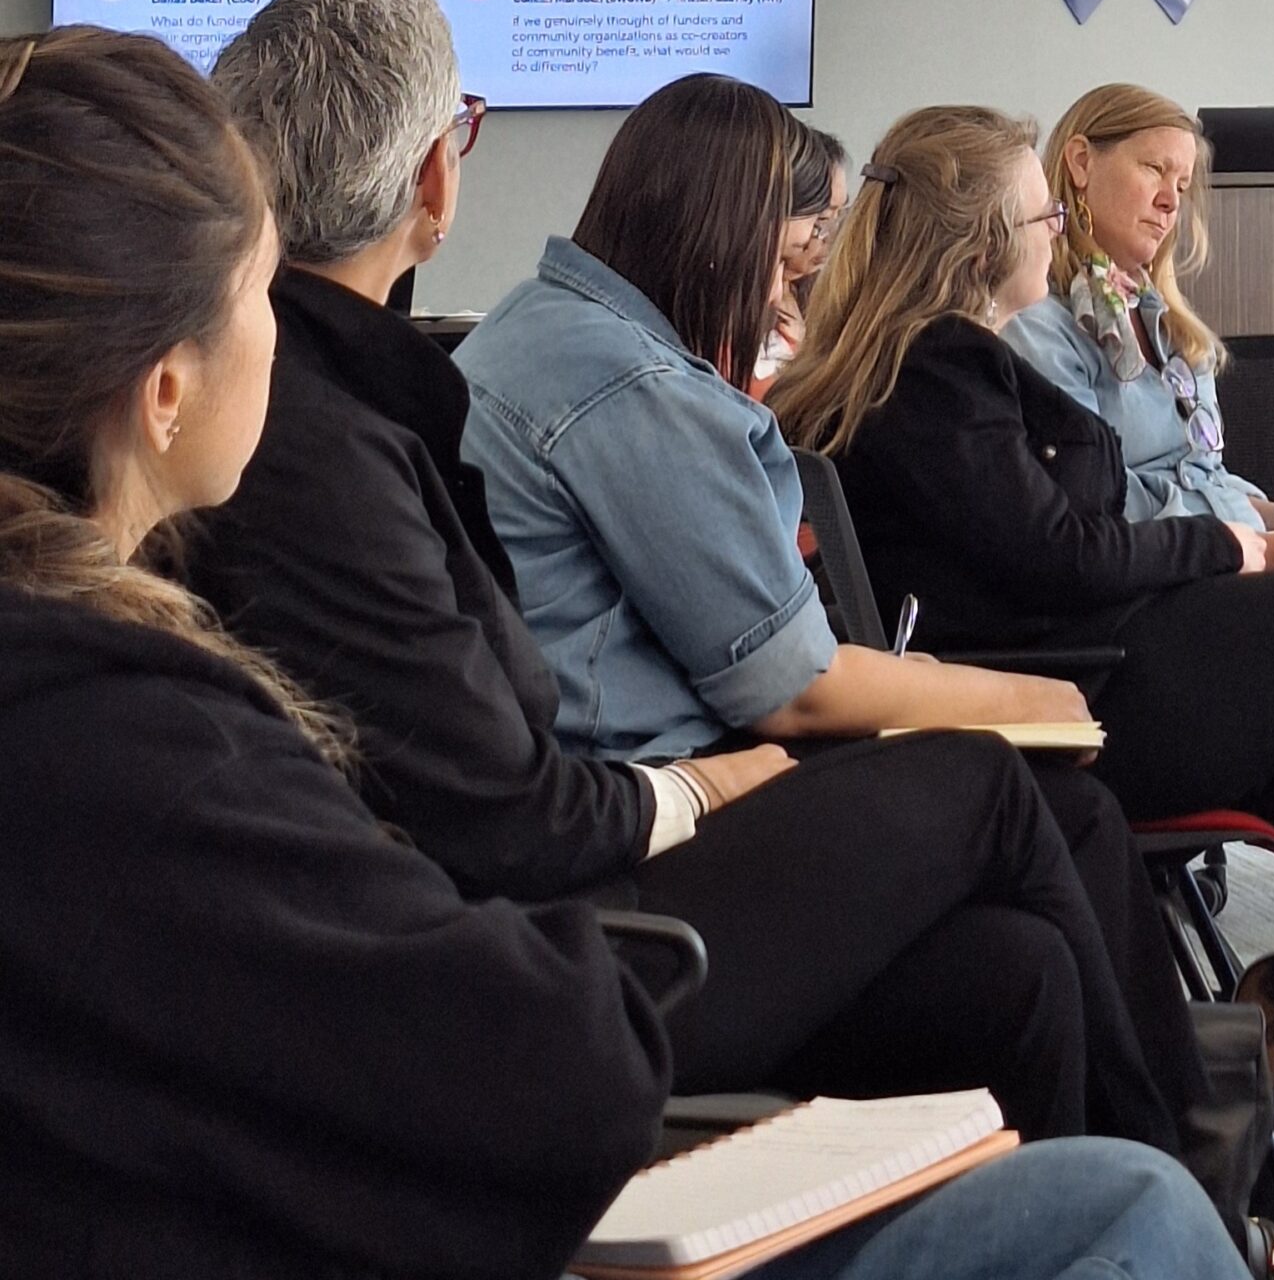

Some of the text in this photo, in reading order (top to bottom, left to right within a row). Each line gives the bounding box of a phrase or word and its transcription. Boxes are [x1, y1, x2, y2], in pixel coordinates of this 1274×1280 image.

[151, 15, 257, 27] What do funder
[524, 17, 541, 26] we
[544, 15, 604, 28] genuinely
[607, 15, 654, 28] thought
[657, 15, 669, 25] of
[673, 14, 718, 25] funders
[721, 14, 743, 25] and
[512, 30, 748, 43] community organizations as co-creators
[512, 47, 524, 57] of
[527, 46, 592, 58] community
[643, 45, 671, 56] what
[674, 45, 711, 56] would
[713, 47, 730, 56] we
[512, 61, 598, 74] do differently?
